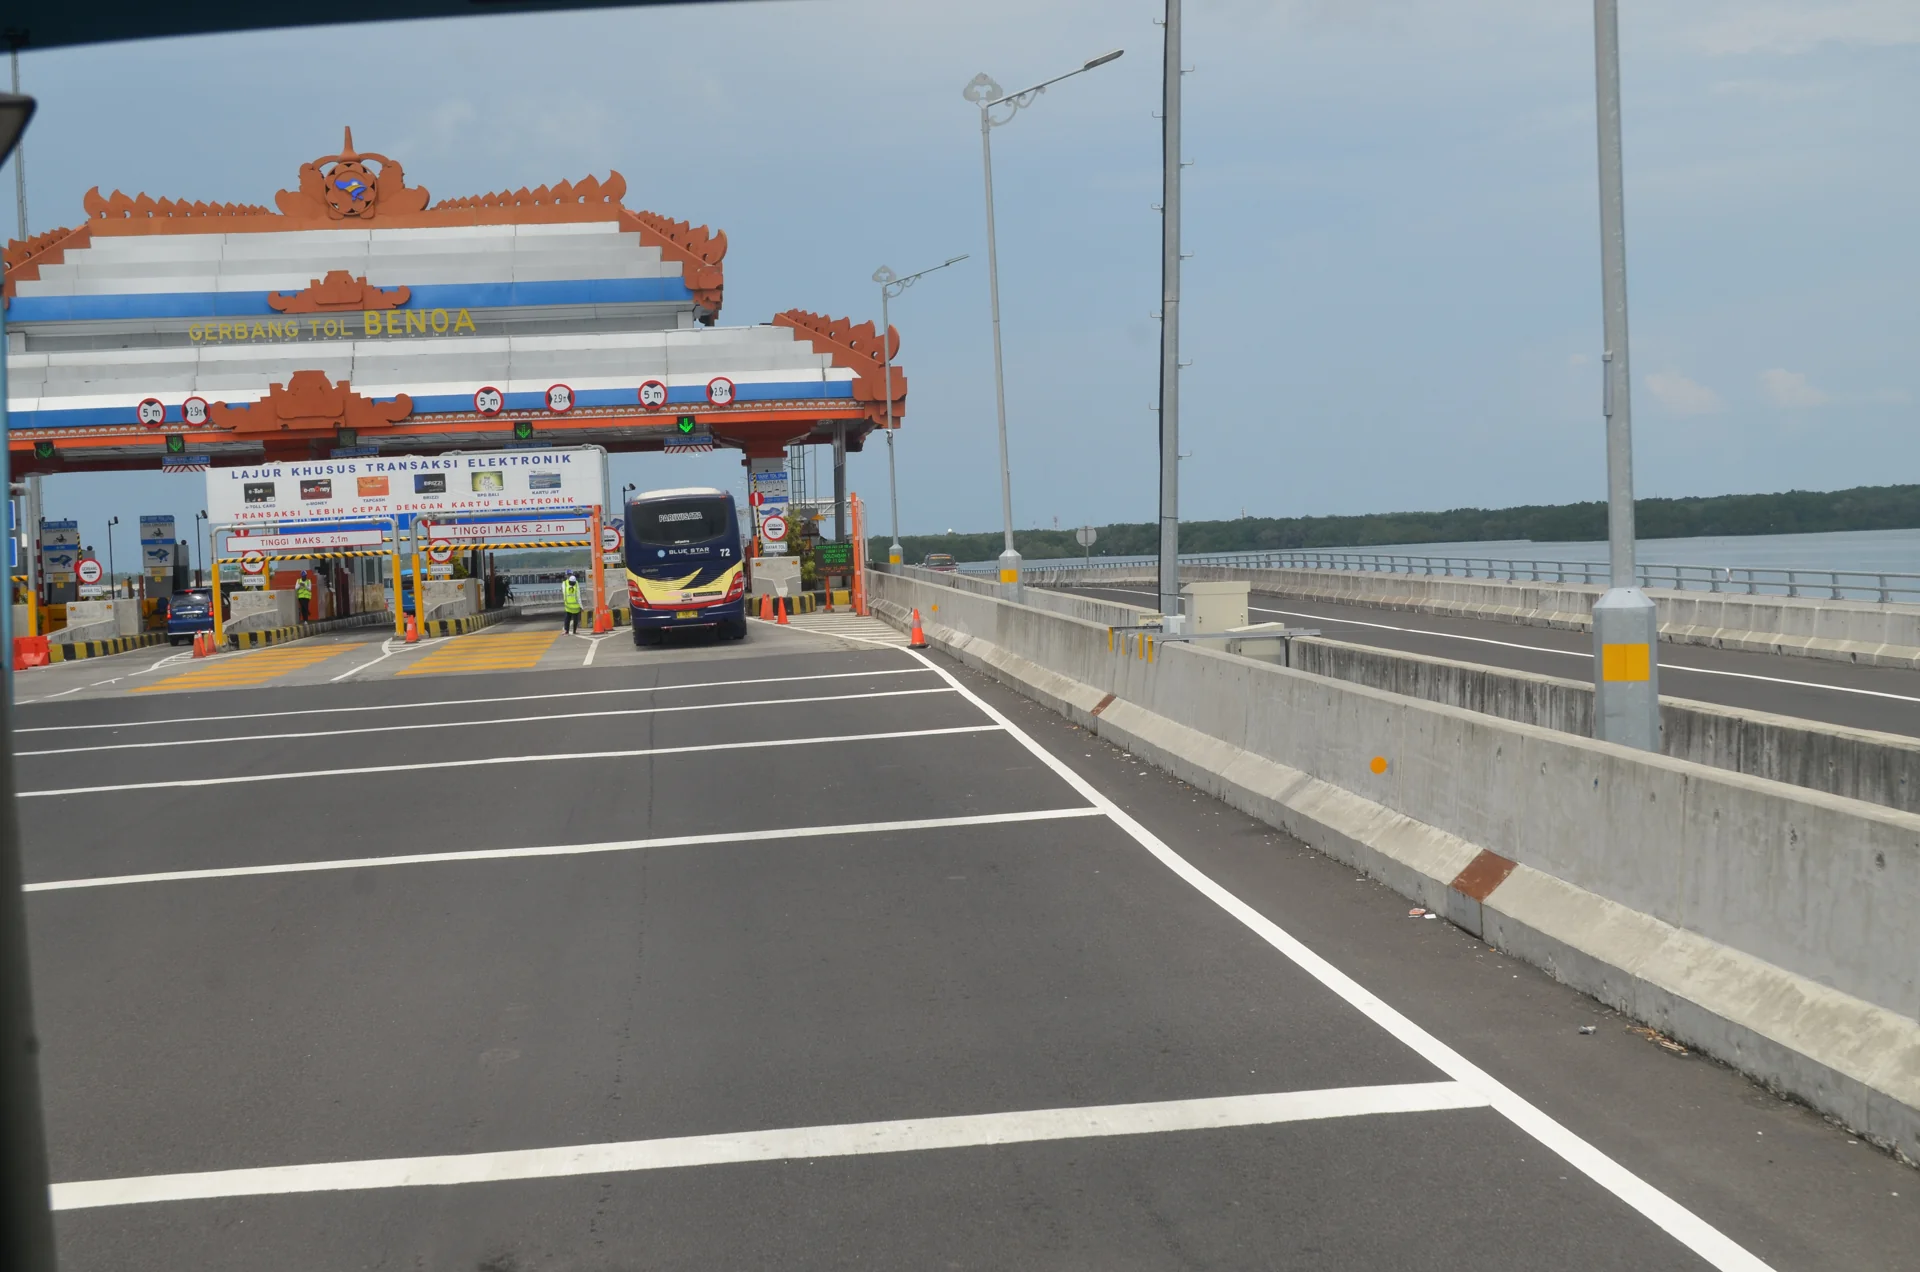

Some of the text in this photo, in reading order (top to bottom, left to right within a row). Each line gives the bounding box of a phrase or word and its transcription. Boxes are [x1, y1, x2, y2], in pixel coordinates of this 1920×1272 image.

[188, 309, 476, 341] GERBANG TOL BENOA
[644, 390, 650, 399] 5
[480, 397, 486, 406] 5
[143, 408, 149, 418] 5
[232, 454, 572, 480] LAJUR KHUSUS TRANSAKSI ELEKTRONIK
[234, 510, 300, 519] TRANSAKSI
[309, 508, 344, 516] LEBIH
[396, 502, 443, 511] DENGAN
[498, 497, 574, 506] ELEKTRONIK
[658, 512, 703, 522] PARIWISATA
[452, 525, 490, 535] TINGGI
[495, 524, 532, 534] MAKS.
[261, 538, 289, 546] TINGGI
[295, 536, 324, 545] MAKS.
[720, 548, 730, 557] 72
